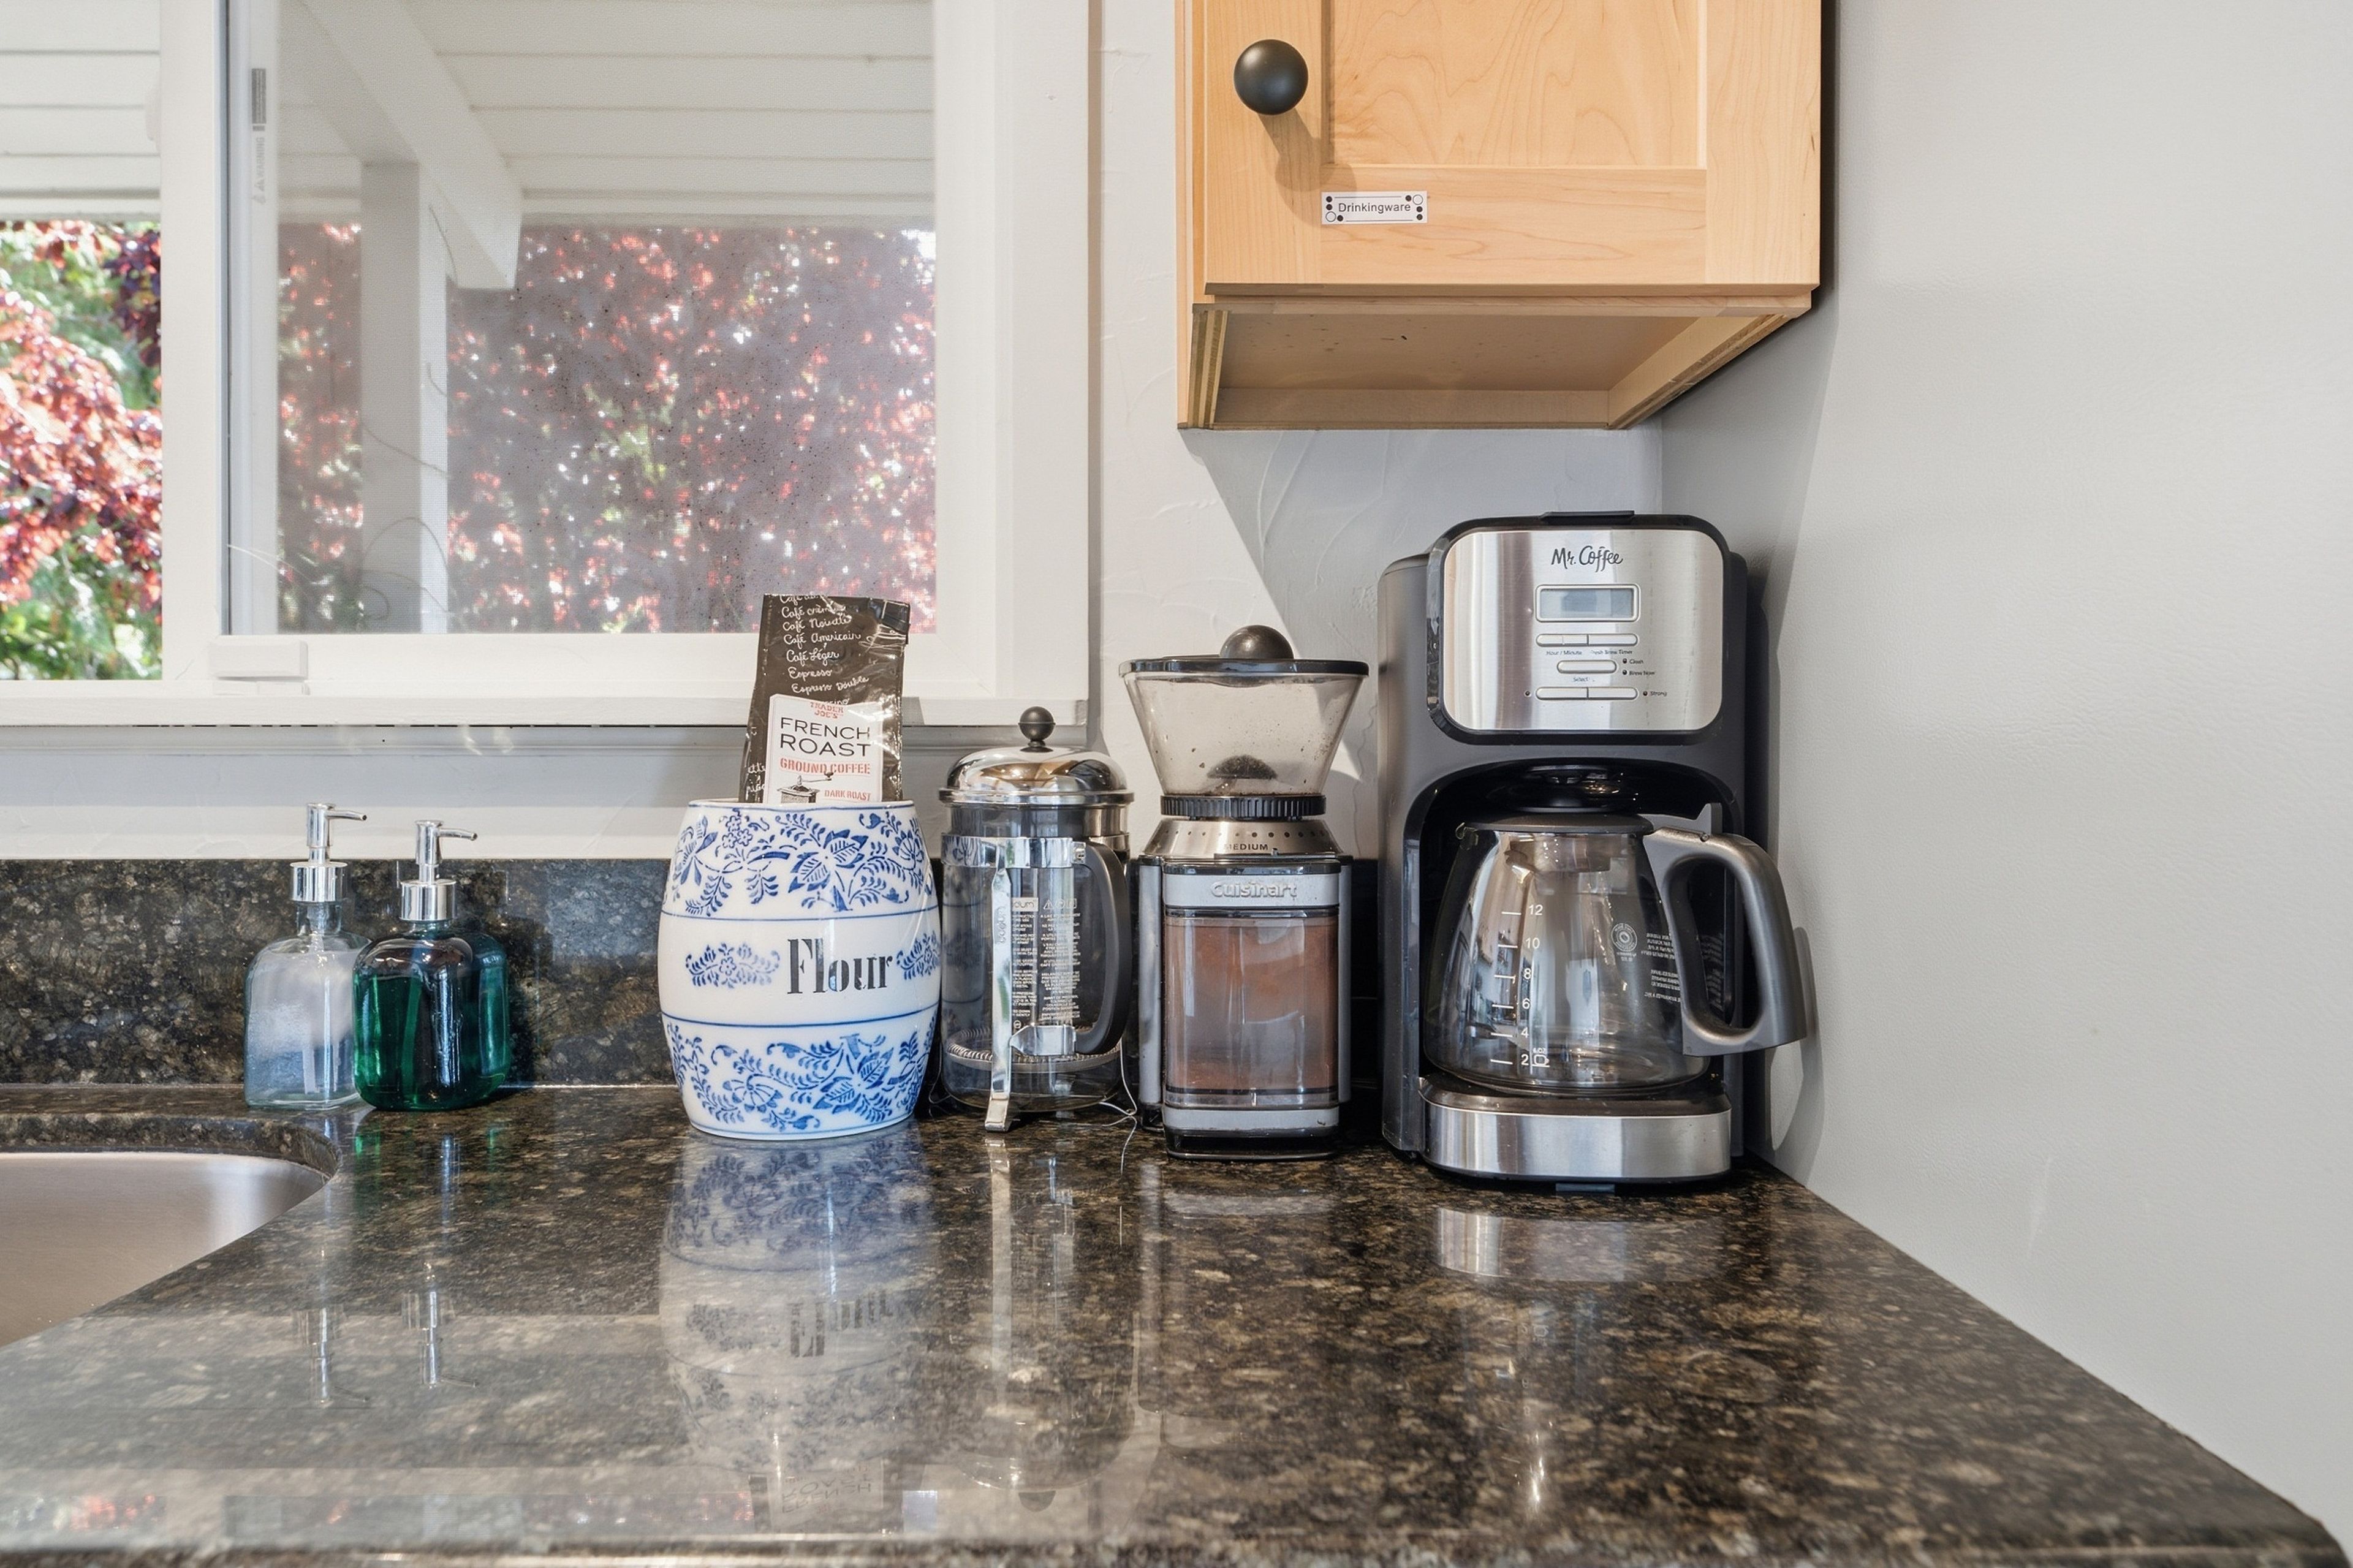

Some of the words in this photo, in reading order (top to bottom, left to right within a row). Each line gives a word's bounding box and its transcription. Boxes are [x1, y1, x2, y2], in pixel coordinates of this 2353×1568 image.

[1338, 203, 1411, 214] Drinkingware
[1551, 547, 1576, 569] Mr.
[1579, 545, 1624, 572] Coffee
[781, 606, 805, 620] Café
[784, 632, 806, 650] Café
[786, 650, 808, 667] Café
[809, 648, 839, 666] Léger
[788, 667, 833, 681] Espresso
[791, 683, 832, 695] Espresso
[810, 702, 844, 713] TRADER
[814, 710, 838, 719] JOE'S
[781, 716, 870, 740] FRENCH
[780, 733, 871, 757] ROAST
[780, 757, 827, 775] GROUND
[830, 762, 871, 775] COFFEE
[847, 791, 871, 801] ROAST
[1211, 879, 1297, 898] Cuisinart
[1528, 904, 1544, 916] 12
[1525, 937, 1540, 950] 10
[787, 938, 893, 994] Flour
[1523, 968, 1531, 980] 8
[1522, 998, 1531, 1009] 6
[1521, 1027, 1529, 1039] 4
[1521, 1053, 1529, 1066] 2
